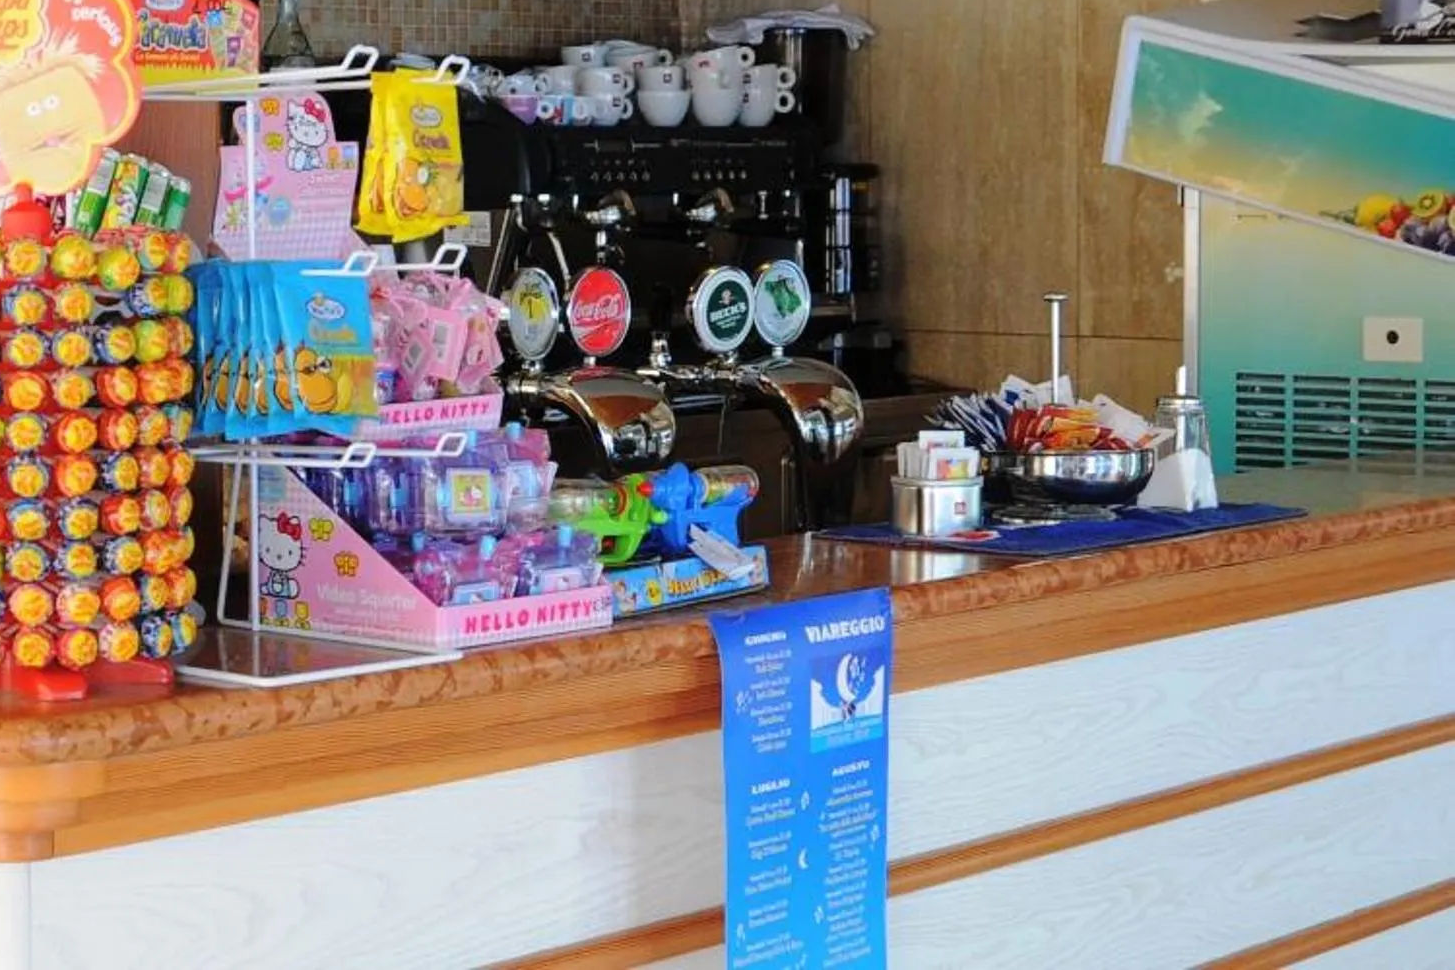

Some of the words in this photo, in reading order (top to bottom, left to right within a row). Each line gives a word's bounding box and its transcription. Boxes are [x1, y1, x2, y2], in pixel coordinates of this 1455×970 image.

[440, 401, 490, 421] KITTY
[464, 610, 529, 635] HELLO
[536, 600, 592, 627] KITTY
[805, 615, 886, 644] VIAREGGIO
